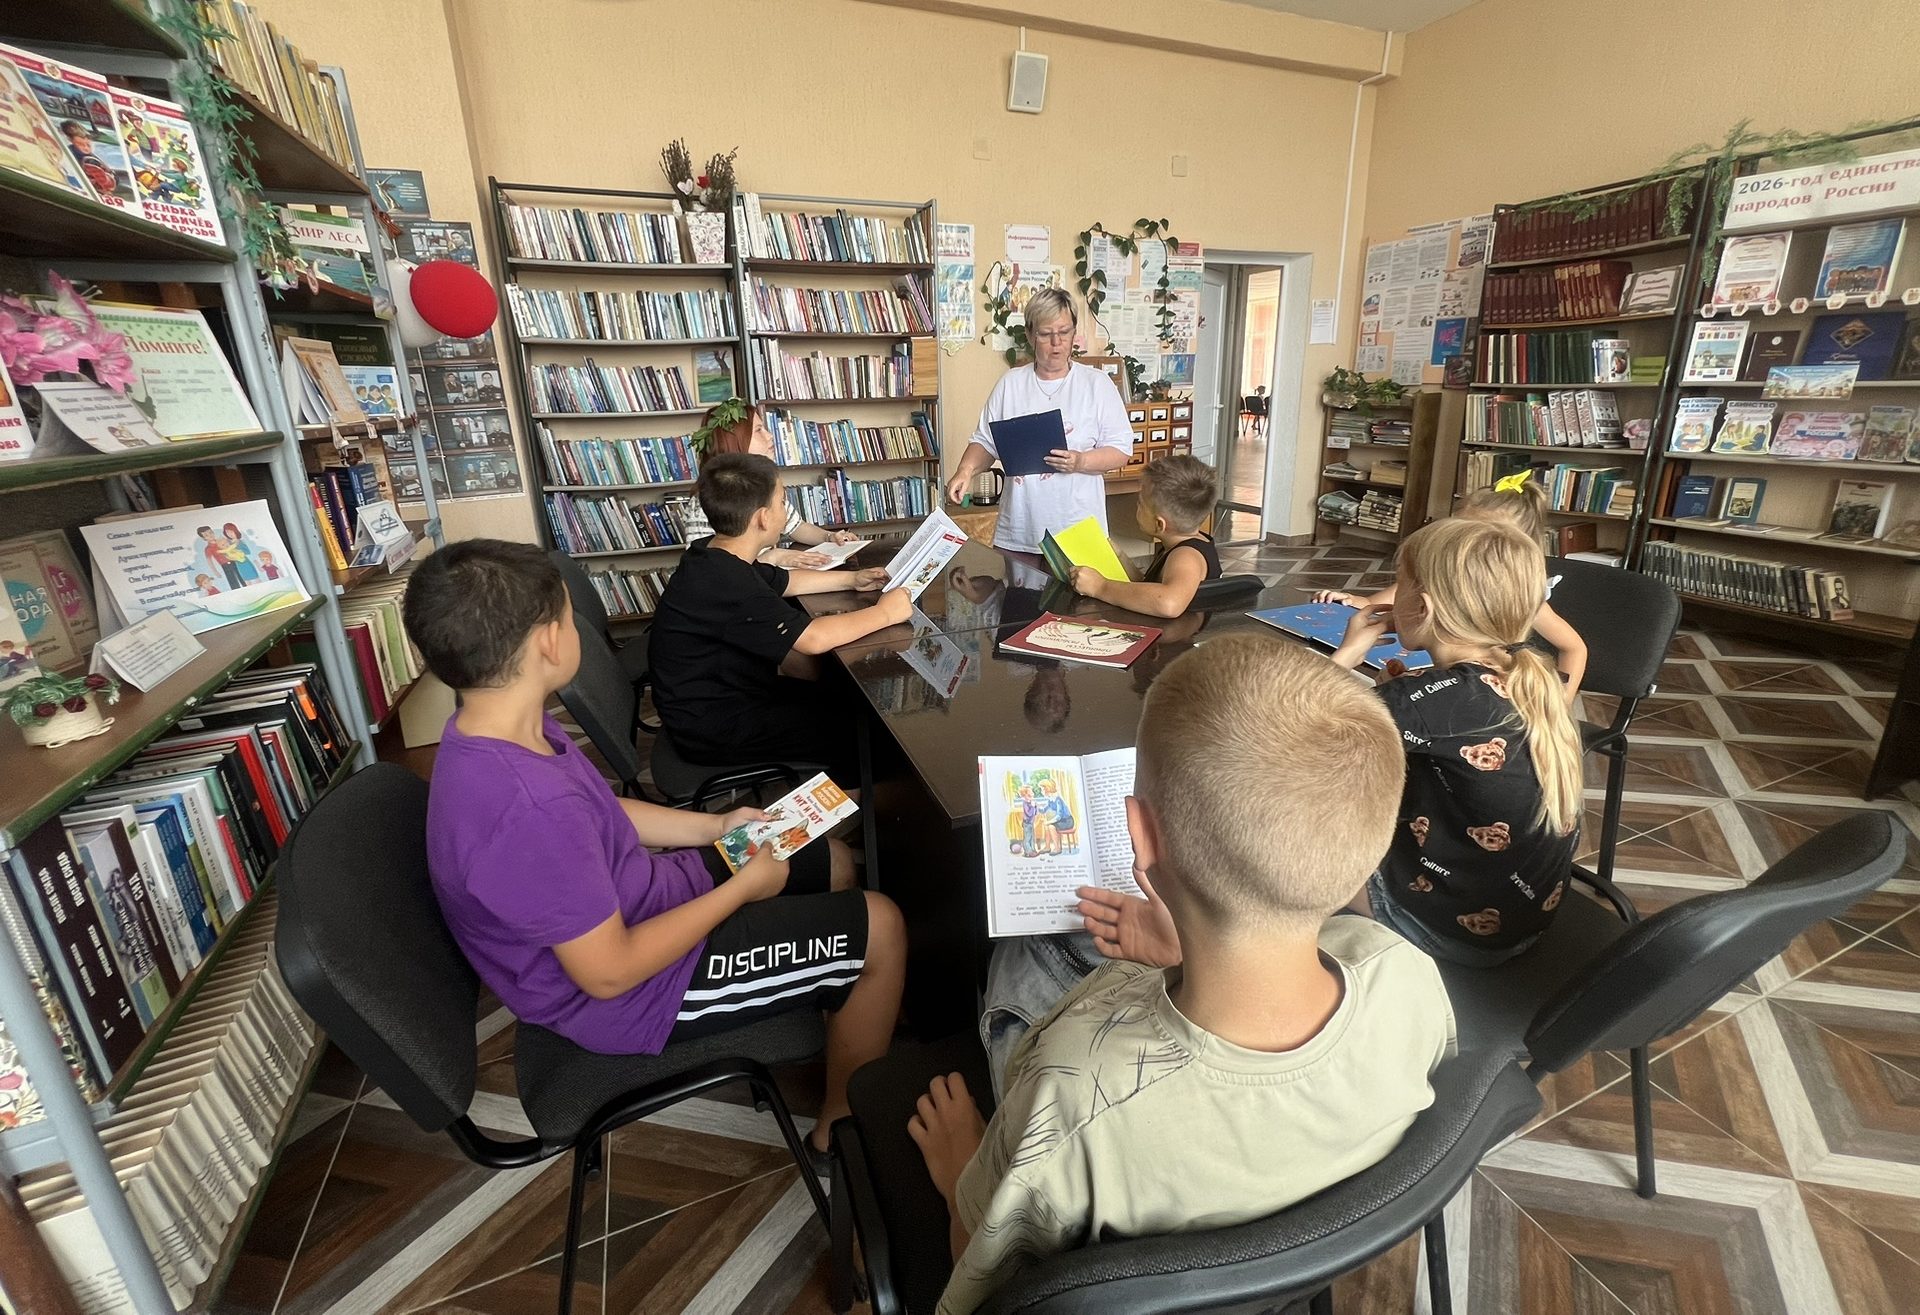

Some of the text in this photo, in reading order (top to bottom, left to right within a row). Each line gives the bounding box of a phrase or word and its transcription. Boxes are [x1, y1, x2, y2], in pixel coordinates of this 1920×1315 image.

[1738, 174, 1823, 195] 2026-год
[1734, 181, 1897, 213] народов России
[294, 227, 363, 245] МИР ЛЕСА
[123, 336, 207, 354] Помните!
[11, 587, 48, 606] НАЯ
[15, 602, 54, 622] ОРА
[1425, 677, 1459, 694] Culture
[793, 794, 808, 807] КИТ
[808, 811, 823, 825] КОТ
[1420, 857, 1451, 877] Culture
[56, 850, 85, 906] ПОСЛЕ СИДА
[127, 871, 145, 901] СИД
[37, 866, 66, 924] ПОСЛЕ СИДА
[707, 934, 848, 980] DISCIPLINE
